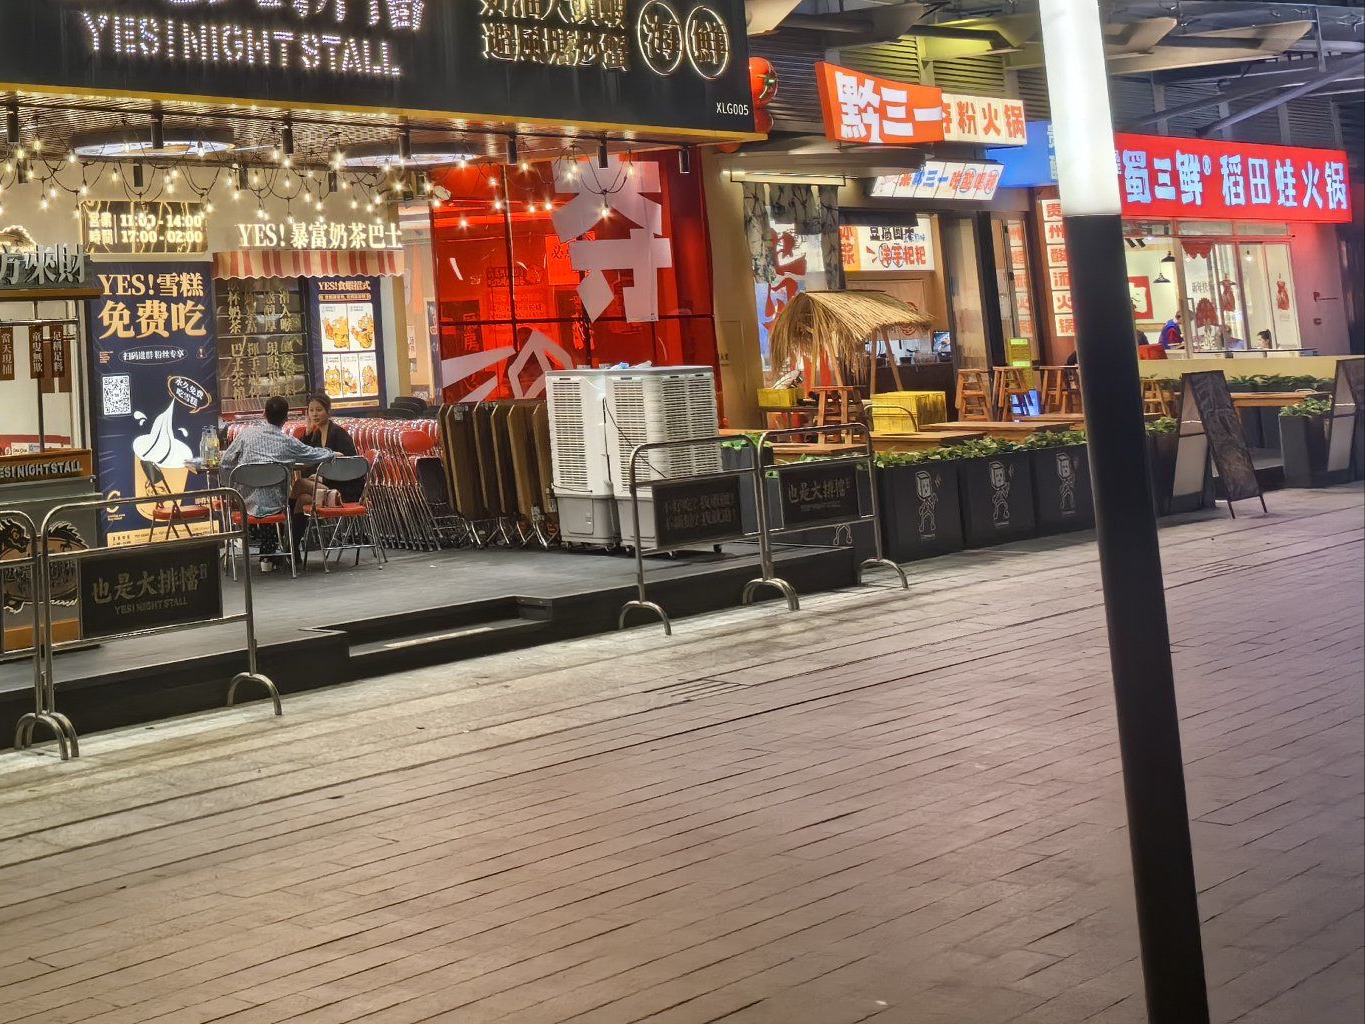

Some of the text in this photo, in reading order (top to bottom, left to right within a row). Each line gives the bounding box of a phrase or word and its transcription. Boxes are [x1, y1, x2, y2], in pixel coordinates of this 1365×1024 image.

[301, 33, 403, 76] STALL
[716, 102, 749, 115] XLG005
[835, 71, 943, 143] 黔三一
[1115, 149, 1203, 206] 蜀三鲜
[1219, 154, 1348, 210] 稻田蛙火锅
[120, 214, 157, 228] 11:00
[166, 214, 202, 228] 14:00
[120, 230, 158, 244] 17:00
[167, 230, 203, 244] 02:00
[98, 299, 207, 340] 免费吃
